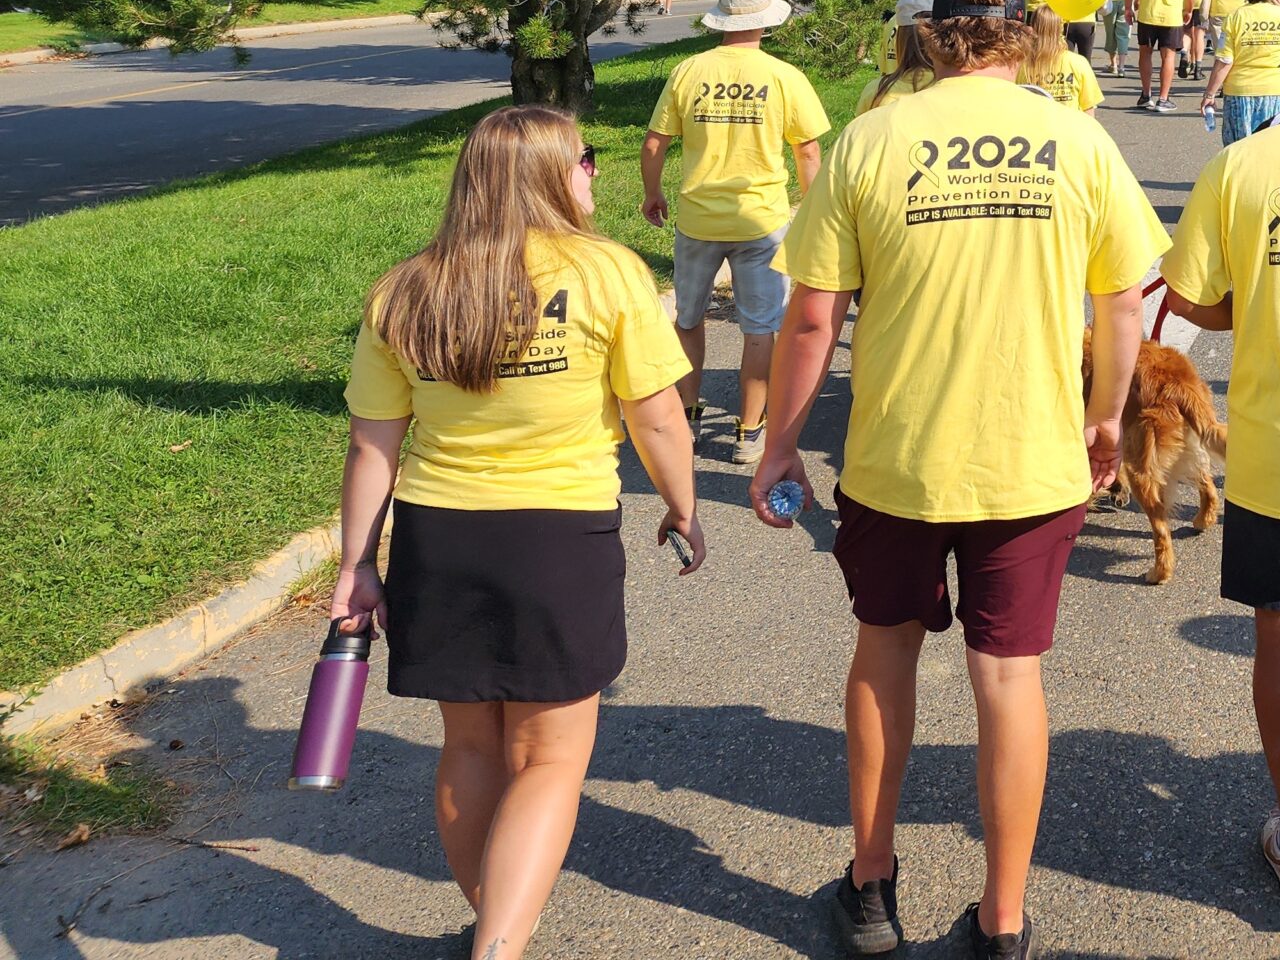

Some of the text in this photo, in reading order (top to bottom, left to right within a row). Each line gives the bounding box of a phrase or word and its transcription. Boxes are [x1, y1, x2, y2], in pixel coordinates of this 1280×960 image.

[714, 83, 768, 101] 2024
[947, 135, 1056, 171] 2024
[948, 172, 1055, 186] World Suicide
[908, 189, 1053, 206] Prevention Day
[908, 206, 1050, 223] HELP IS AVAILABLE: Call or Text 988
[528, 345, 565, 356] Day
[499, 360, 567, 375] Call or Text 988
